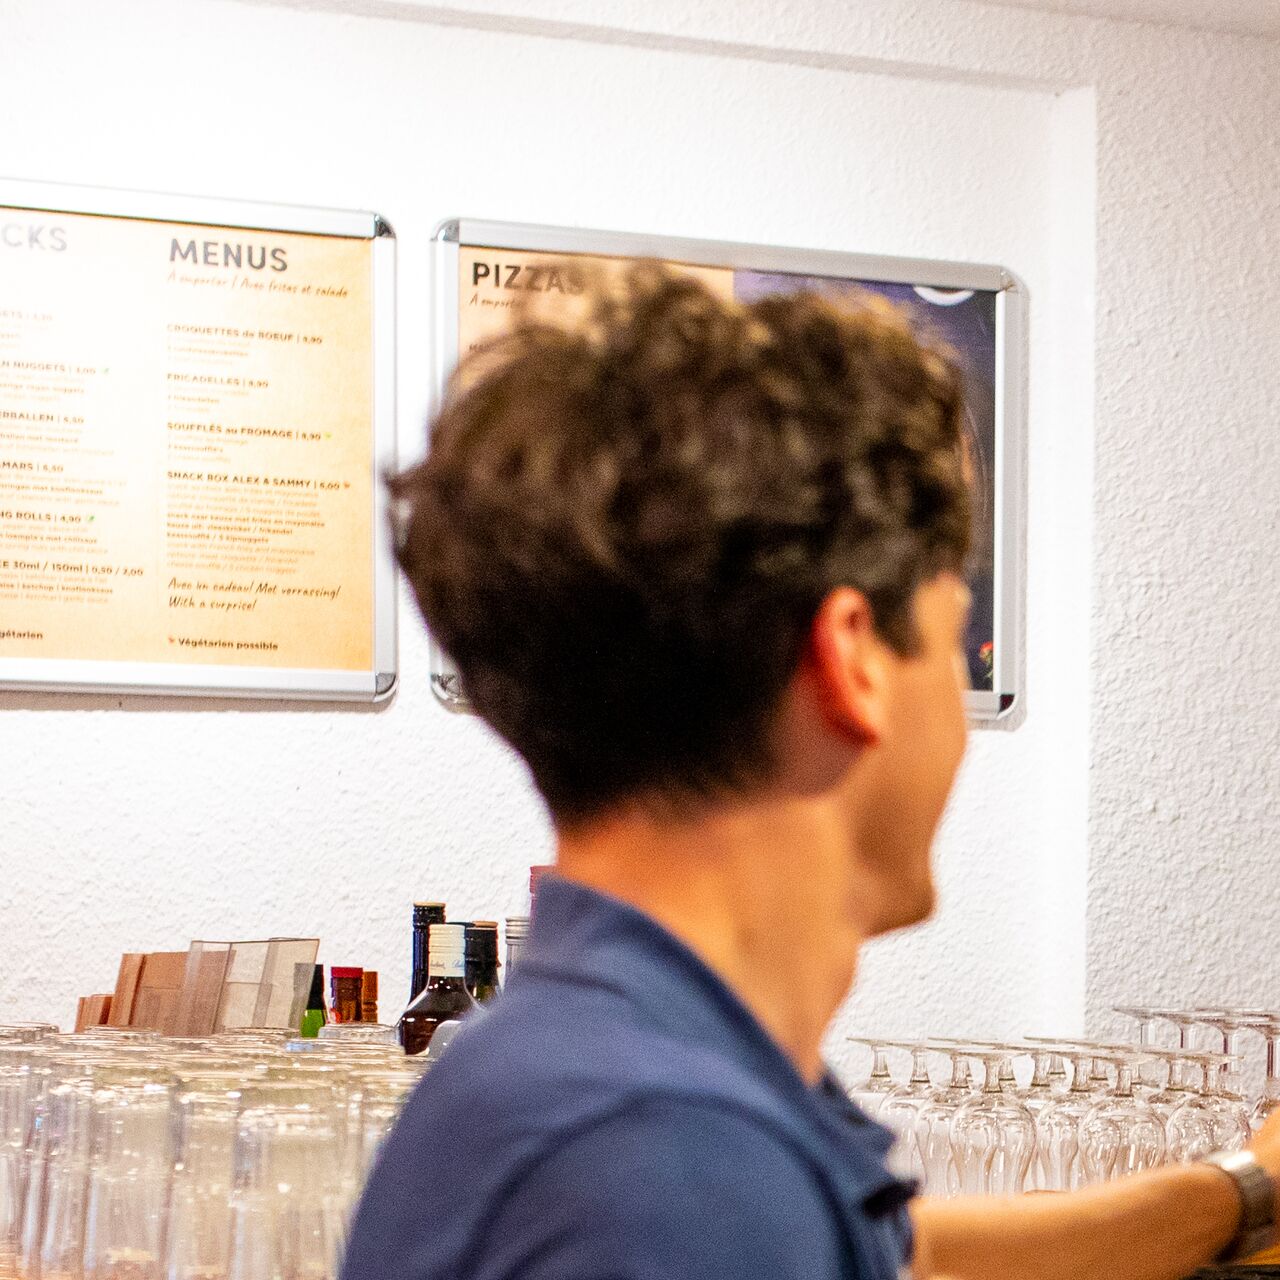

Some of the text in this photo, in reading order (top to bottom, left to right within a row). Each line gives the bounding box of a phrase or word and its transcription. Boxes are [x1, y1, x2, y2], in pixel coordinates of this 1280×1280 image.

[169, 238, 288, 272] MENUS
[316, 286, 348, 298] salade
[167, 324, 239, 338] CROQUETTES
[243, 330, 254, 339] de
[167, 373, 240, 386] FRICADELLES
[167, 421, 222, 434] SOUFFLÉS
[225, 428, 238, 436] au
[240, 428, 293, 440] FROMAGE
[167, 471, 203, 482] SNACK
[207, 473, 228, 483] BOX
[232, 475, 260, 486] ALEX
[272, 478, 311, 490] SAMMY
[16, 512, 51, 521] ROLLS
[14, 561, 40, 571] 30ml
[52, 563, 82, 573] 150ml
[168, 577, 192, 591] Avec
[255, 582, 277, 596] Met
[168, 596, 258, 612] With a surprise!
[178, 638, 278, 651] Végétarien possible
